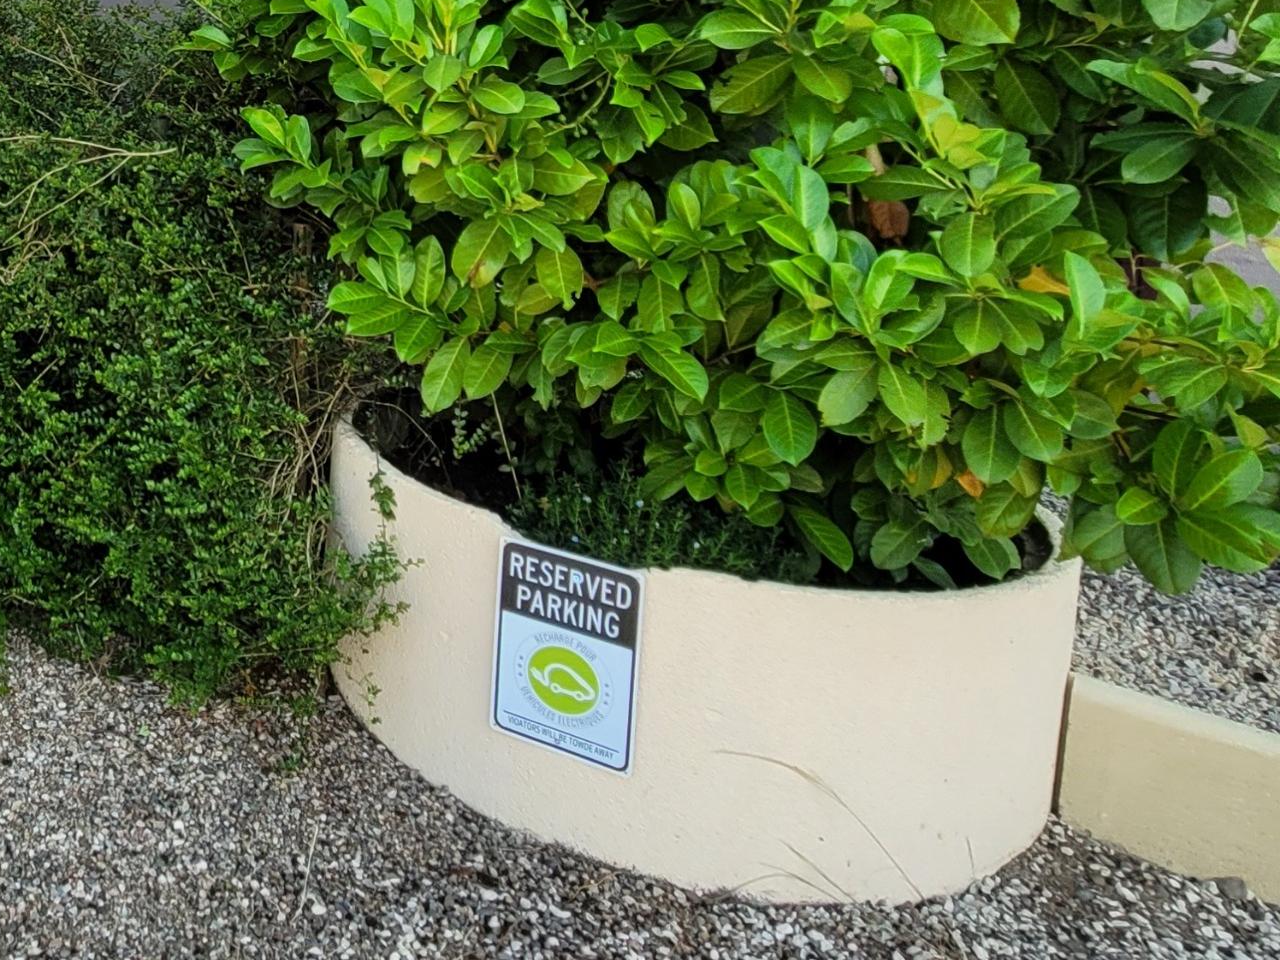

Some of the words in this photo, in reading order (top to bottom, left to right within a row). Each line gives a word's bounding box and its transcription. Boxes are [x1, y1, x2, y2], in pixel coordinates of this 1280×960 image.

[509, 551, 633, 611] RESERVED
[516, 584, 621, 639] PARKING
[558, 733, 568, 744] BE
[594, 746, 614, 760] AWAY
